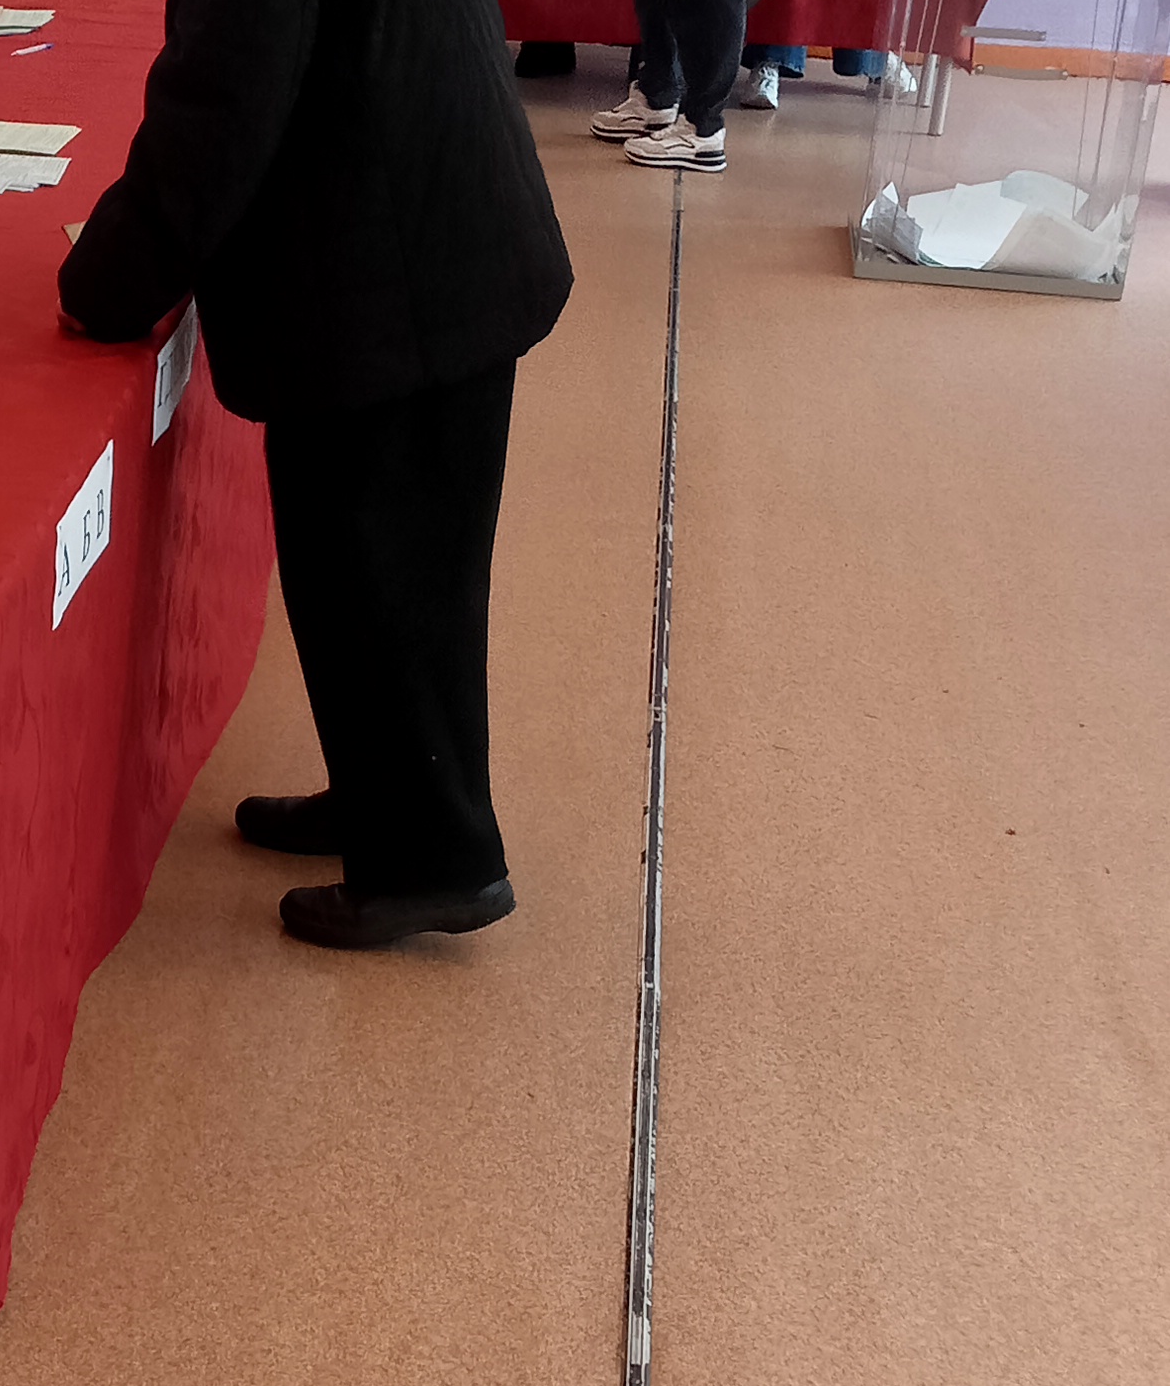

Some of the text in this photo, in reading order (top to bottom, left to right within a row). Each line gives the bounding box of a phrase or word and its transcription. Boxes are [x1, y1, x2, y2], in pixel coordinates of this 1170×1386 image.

[58, 489, 104, 597] А Б В
